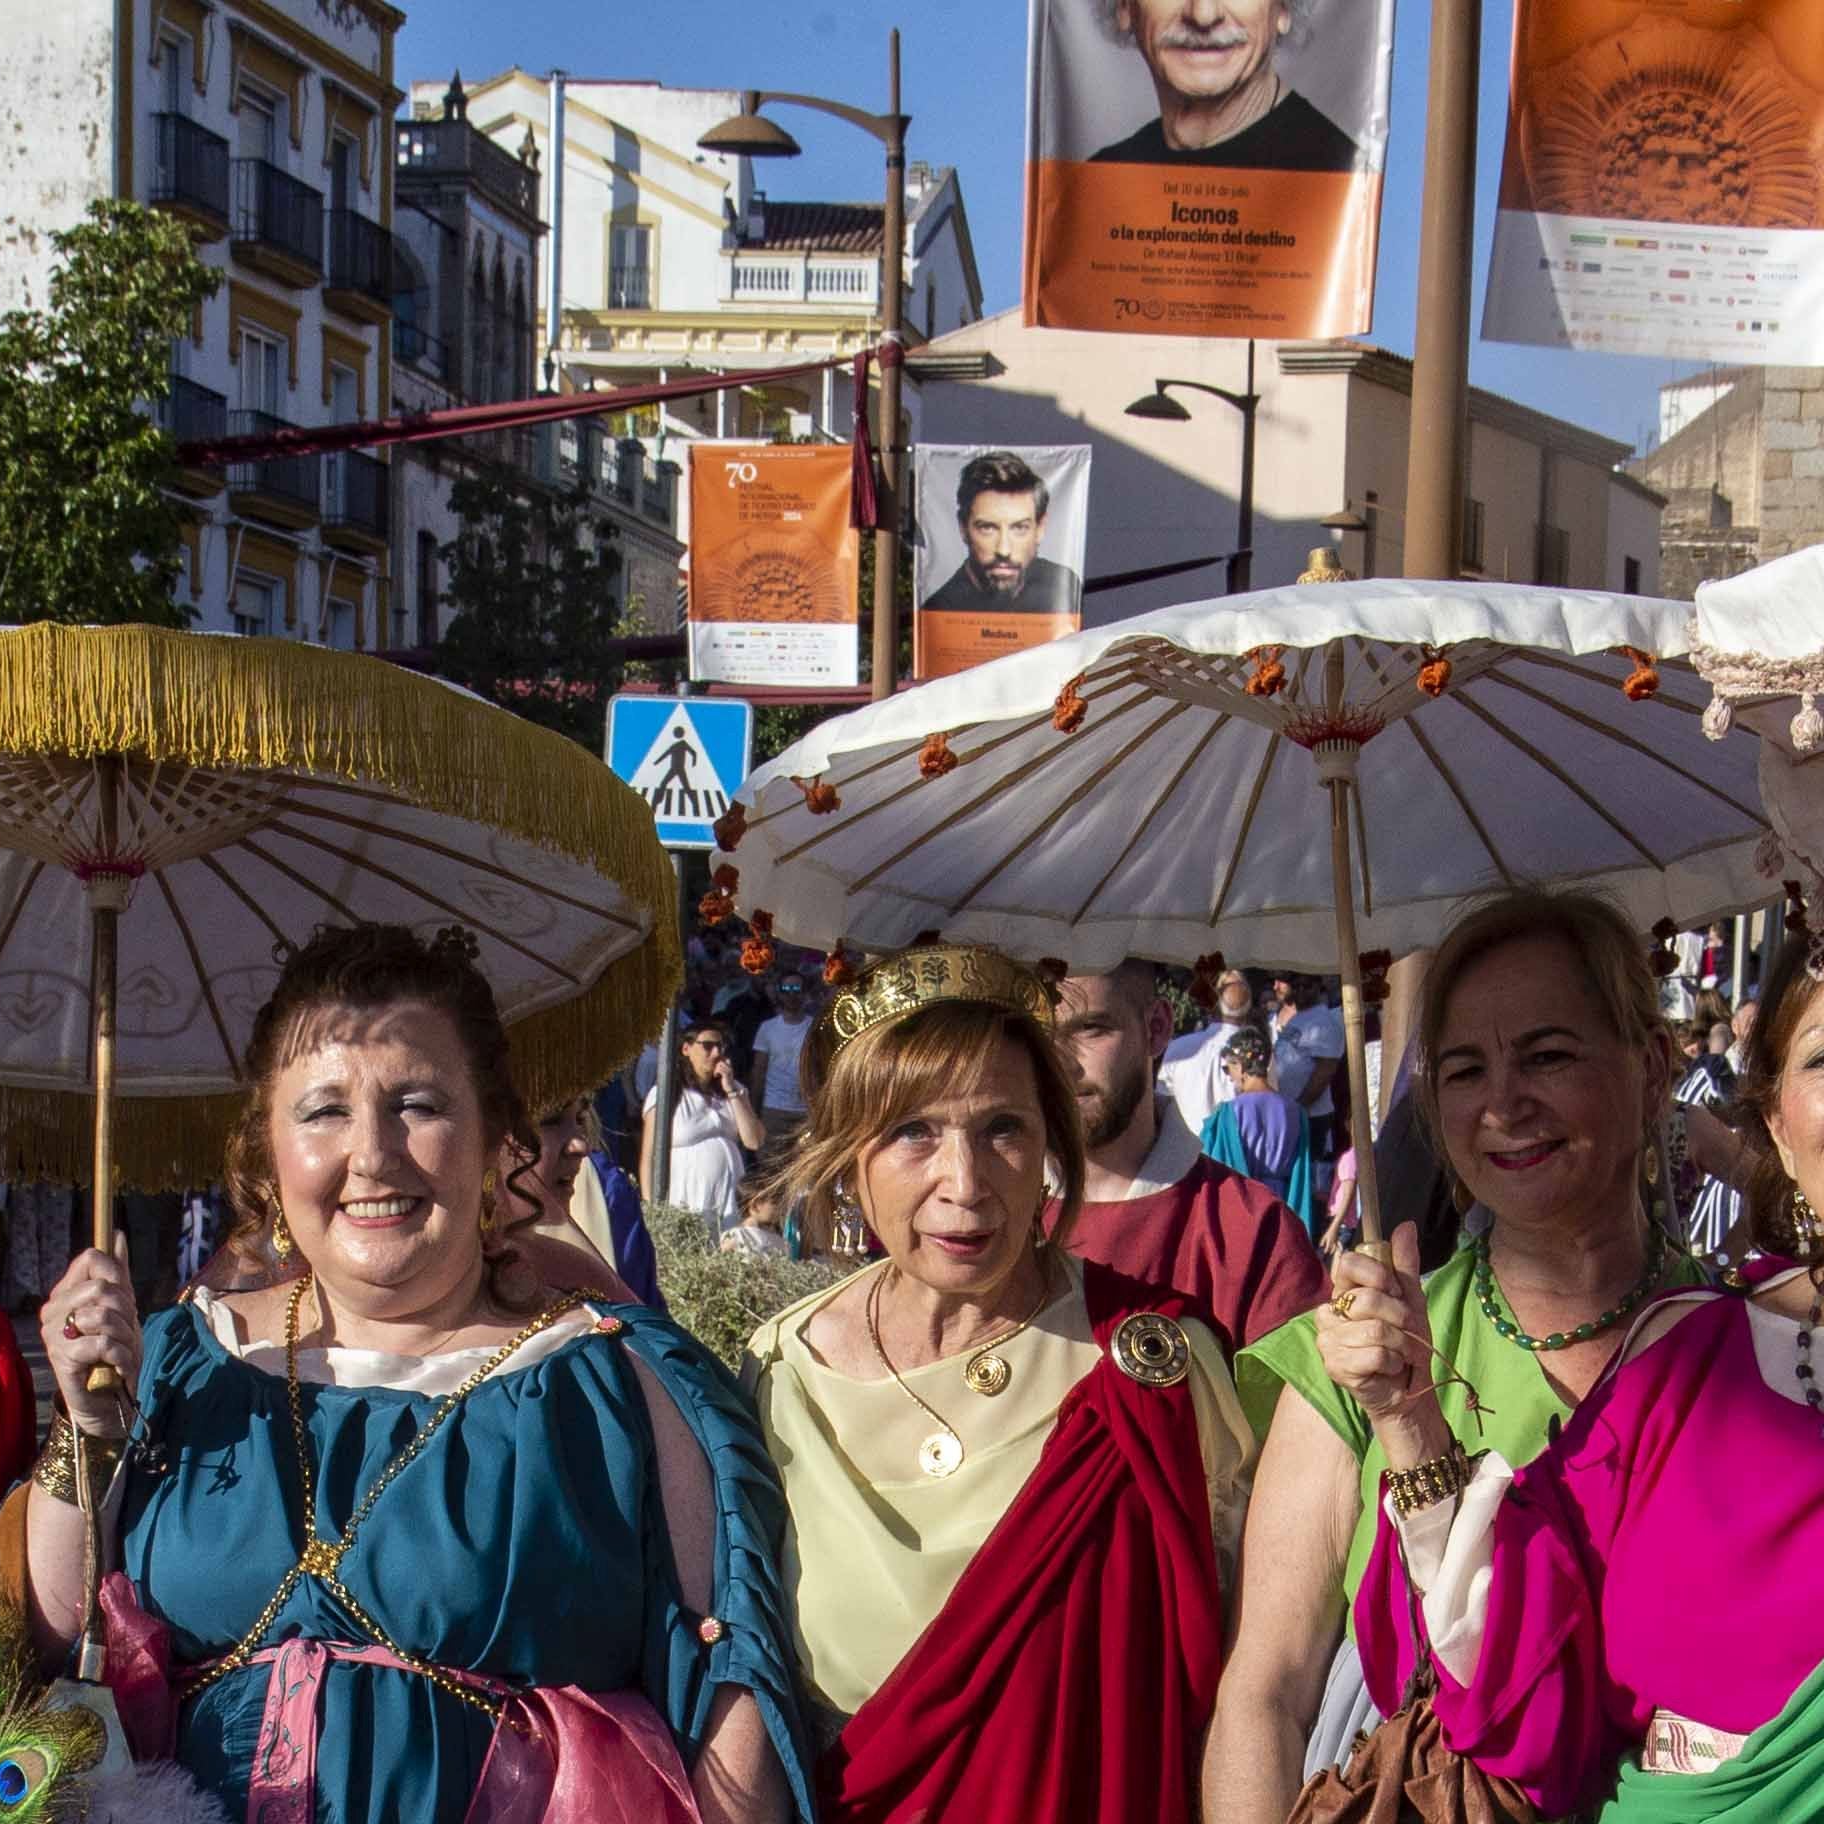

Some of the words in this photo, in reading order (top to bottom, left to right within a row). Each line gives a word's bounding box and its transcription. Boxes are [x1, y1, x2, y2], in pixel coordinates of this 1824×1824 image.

[1172, 201, 1239, 225] Iconos
[1111, 229, 1119, 240] o
[1121, 225, 1134, 240] la
[1137, 227, 1218, 244] exploración
[1221, 230, 1242, 244] del
[1244, 231, 1296, 247] destino
[1114, 299, 1140, 319] 70
[725, 462, 758, 489] 70
